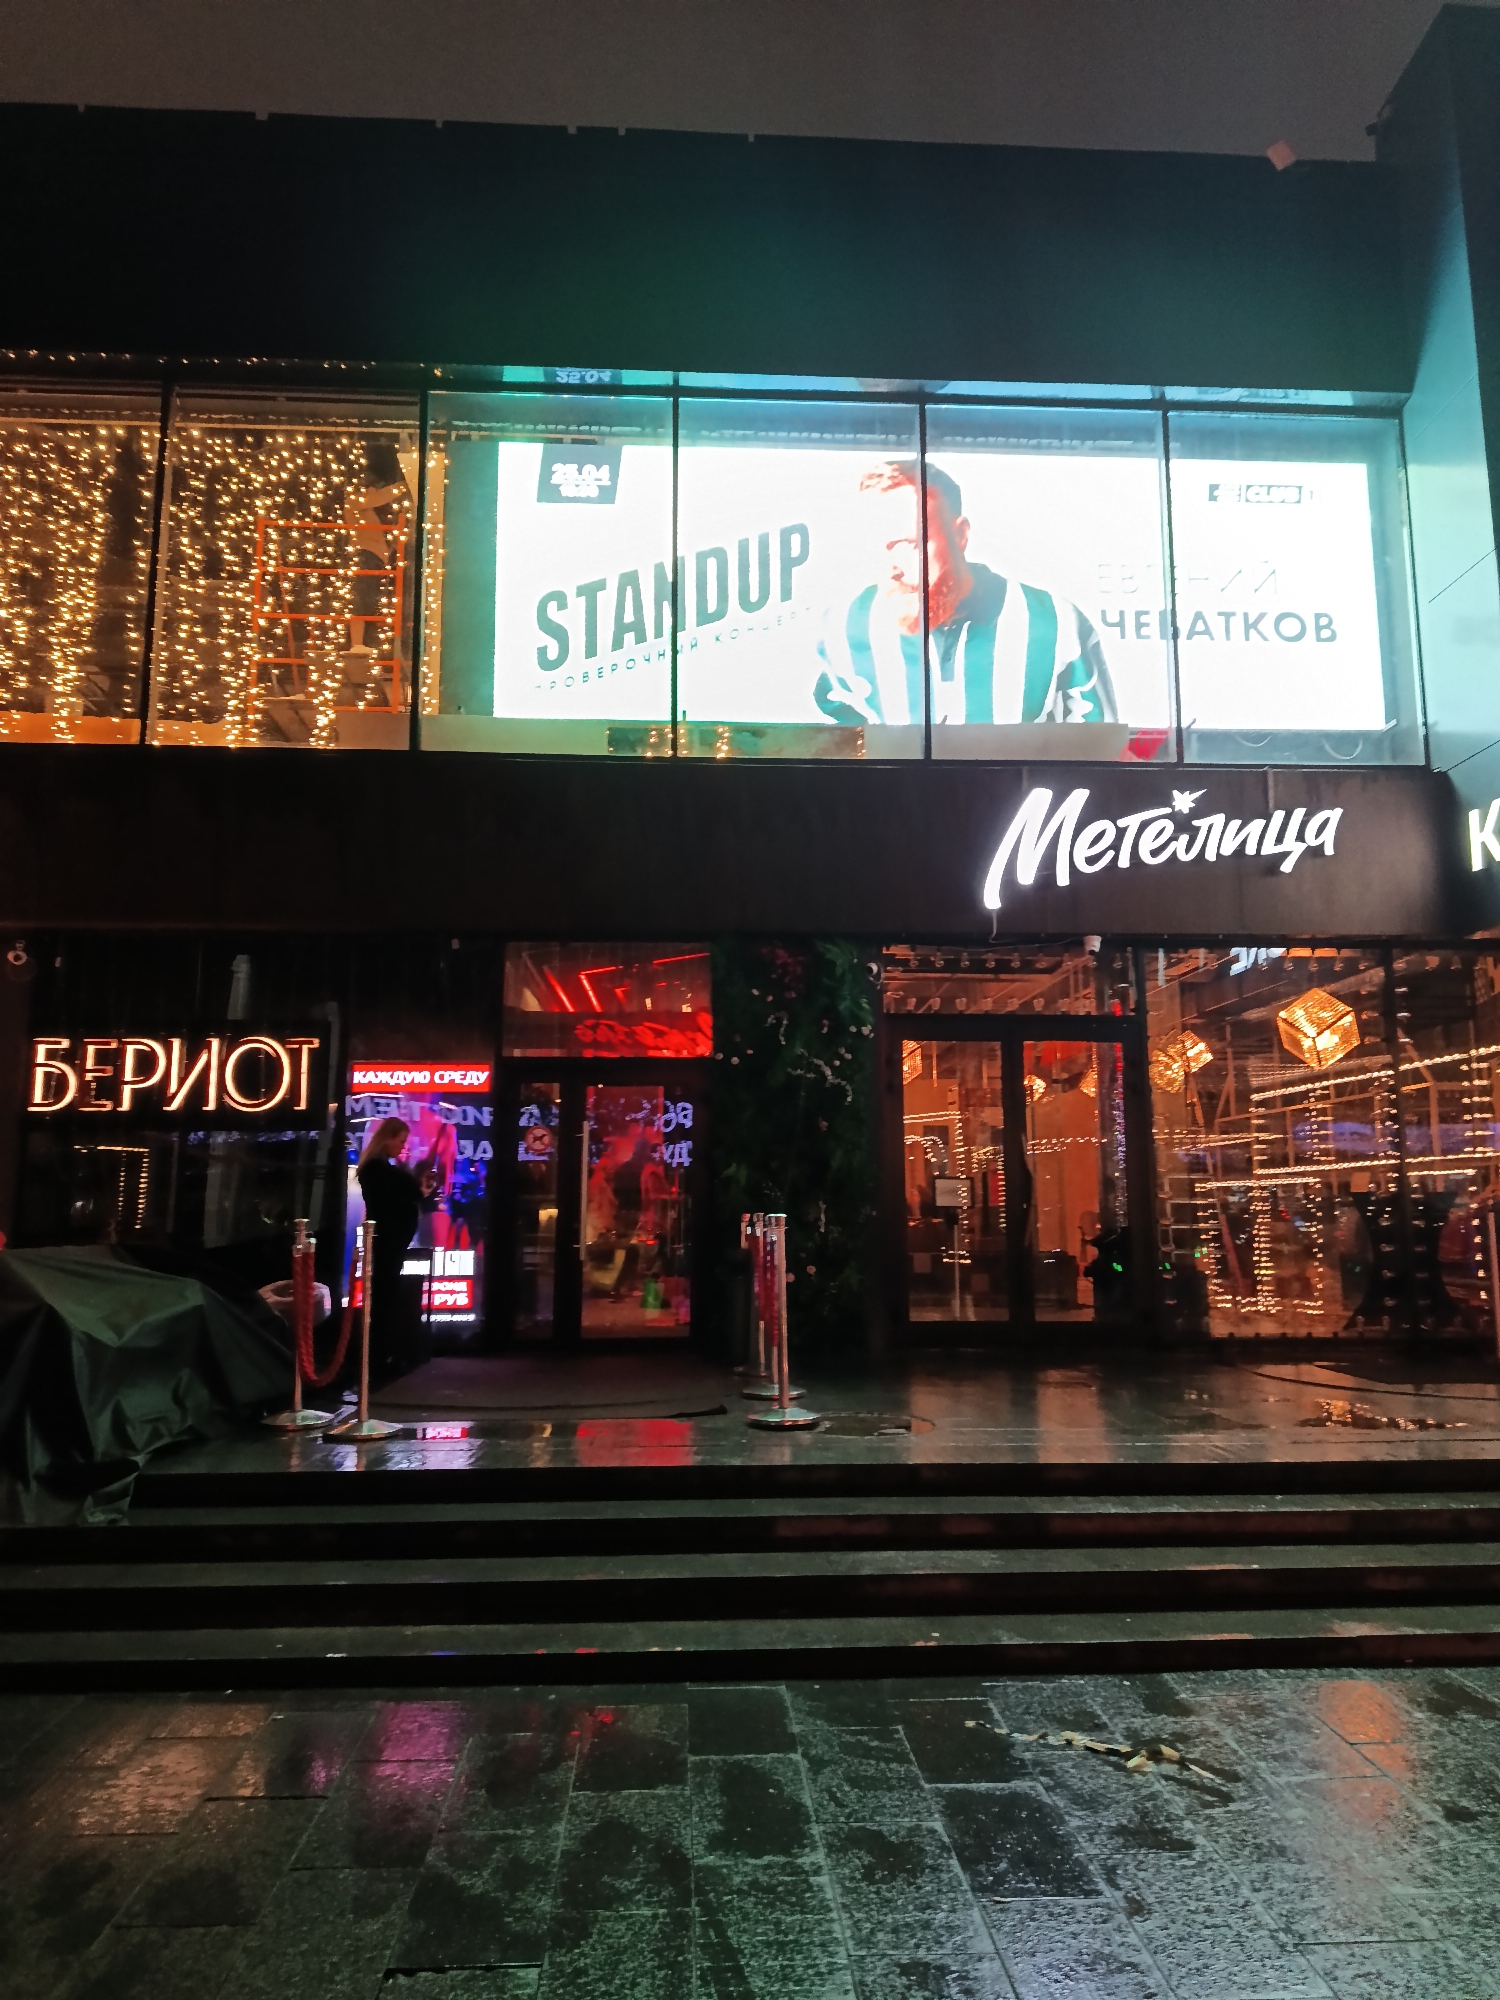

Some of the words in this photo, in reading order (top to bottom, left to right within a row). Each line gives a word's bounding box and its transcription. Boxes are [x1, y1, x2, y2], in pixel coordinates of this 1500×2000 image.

[536, 523, 810, 671] STANDUP
[1098, 560, 1278, 594] ЕВНИЙ
[534, 636, 699, 690] РОВЕРОЧНЫЙ
[714, 605, 811, 644] КОЕР
[1100, 609, 1338, 643] ЧЕВАТКОВ
[983, 787, 1344, 909] Метелица
[27, 1036, 320, 1112] БЕРИОТ
[353, 1070, 430, 1086] КАЖДУЮ
[433, 1070, 490, 1086] СРЕДУ
[433, 1292, 469, 1306] РУБ
